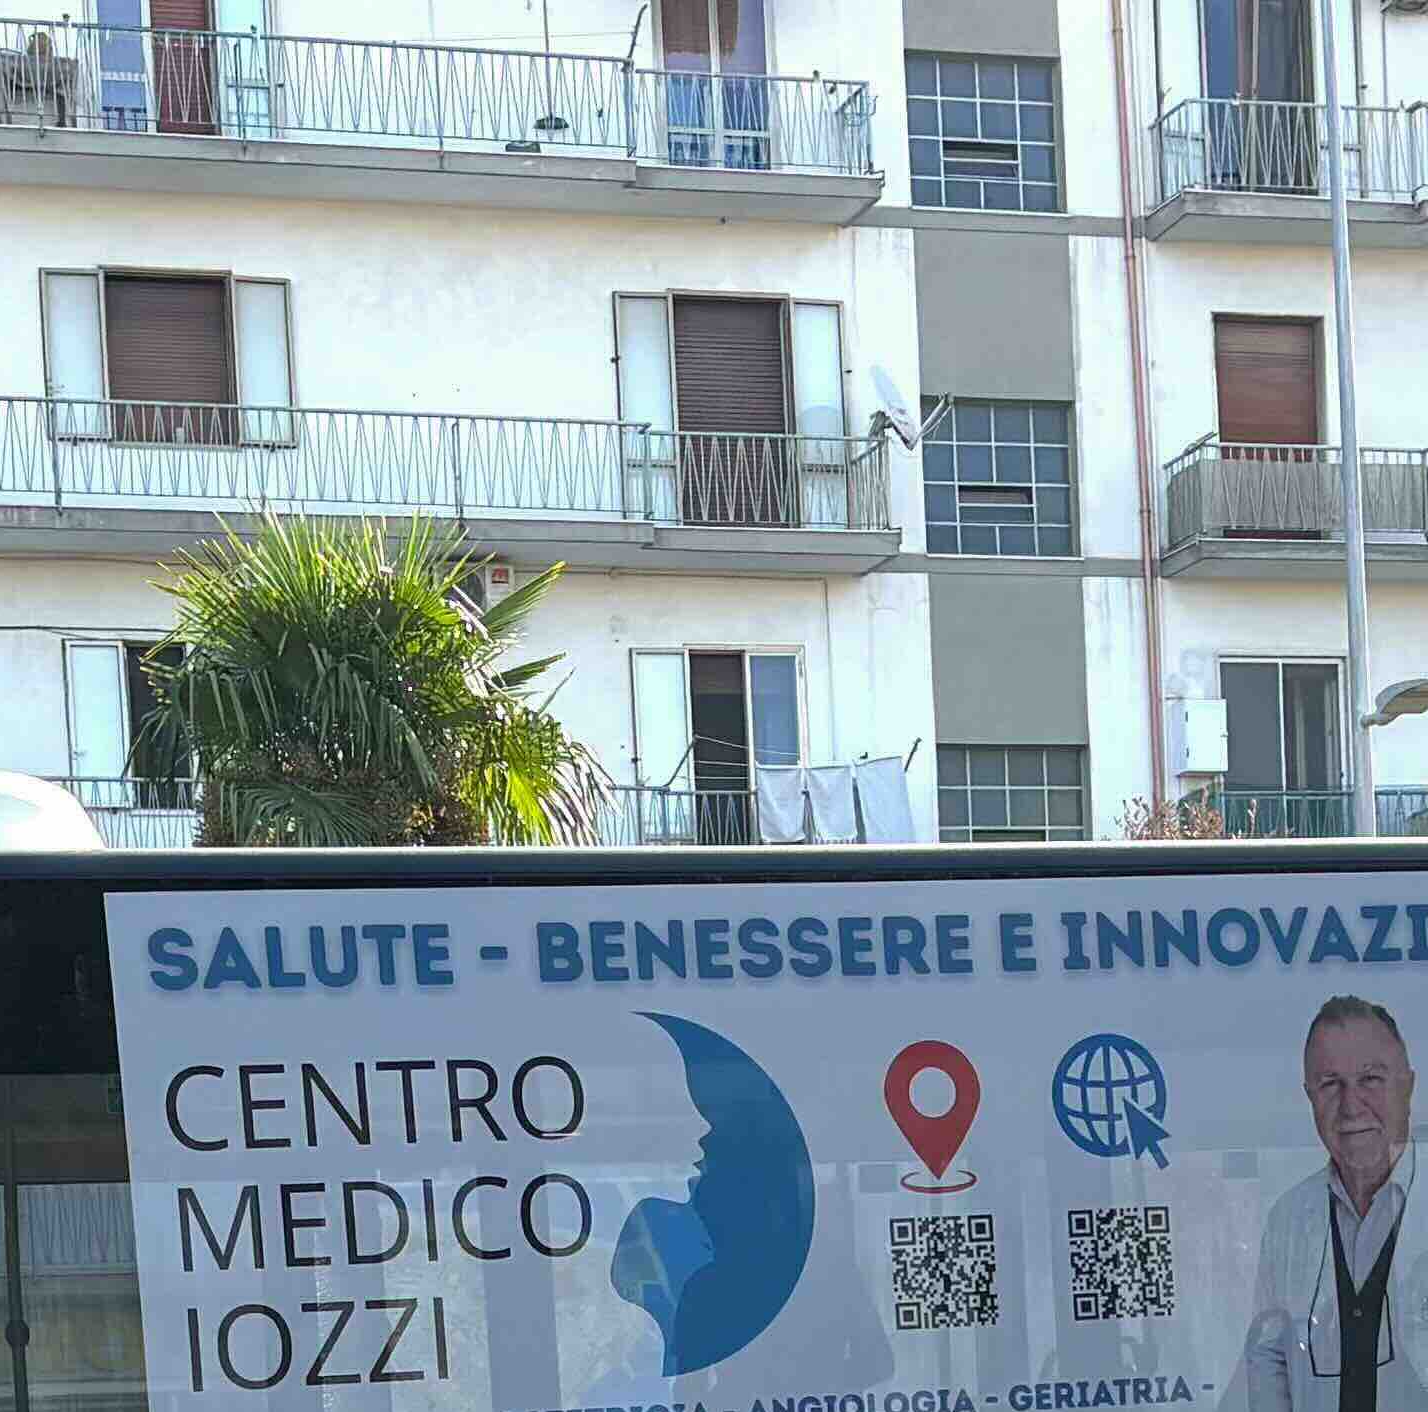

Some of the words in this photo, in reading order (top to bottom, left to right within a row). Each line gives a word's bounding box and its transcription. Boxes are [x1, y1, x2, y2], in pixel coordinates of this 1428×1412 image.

[147, 922, 454, 991] SALUTE
[479, 945, 508, 961] -
[535, 914, 973, 984] BENESSERE
[999, 912, 1037, 972] E
[164, 1055, 585, 1151] CENTRO
[177, 1173, 593, 1273] MEDICO
[188, 1296, 452, 1393] IOZZI
[1008, 1377, 1194, 1412] GERIATRIA
